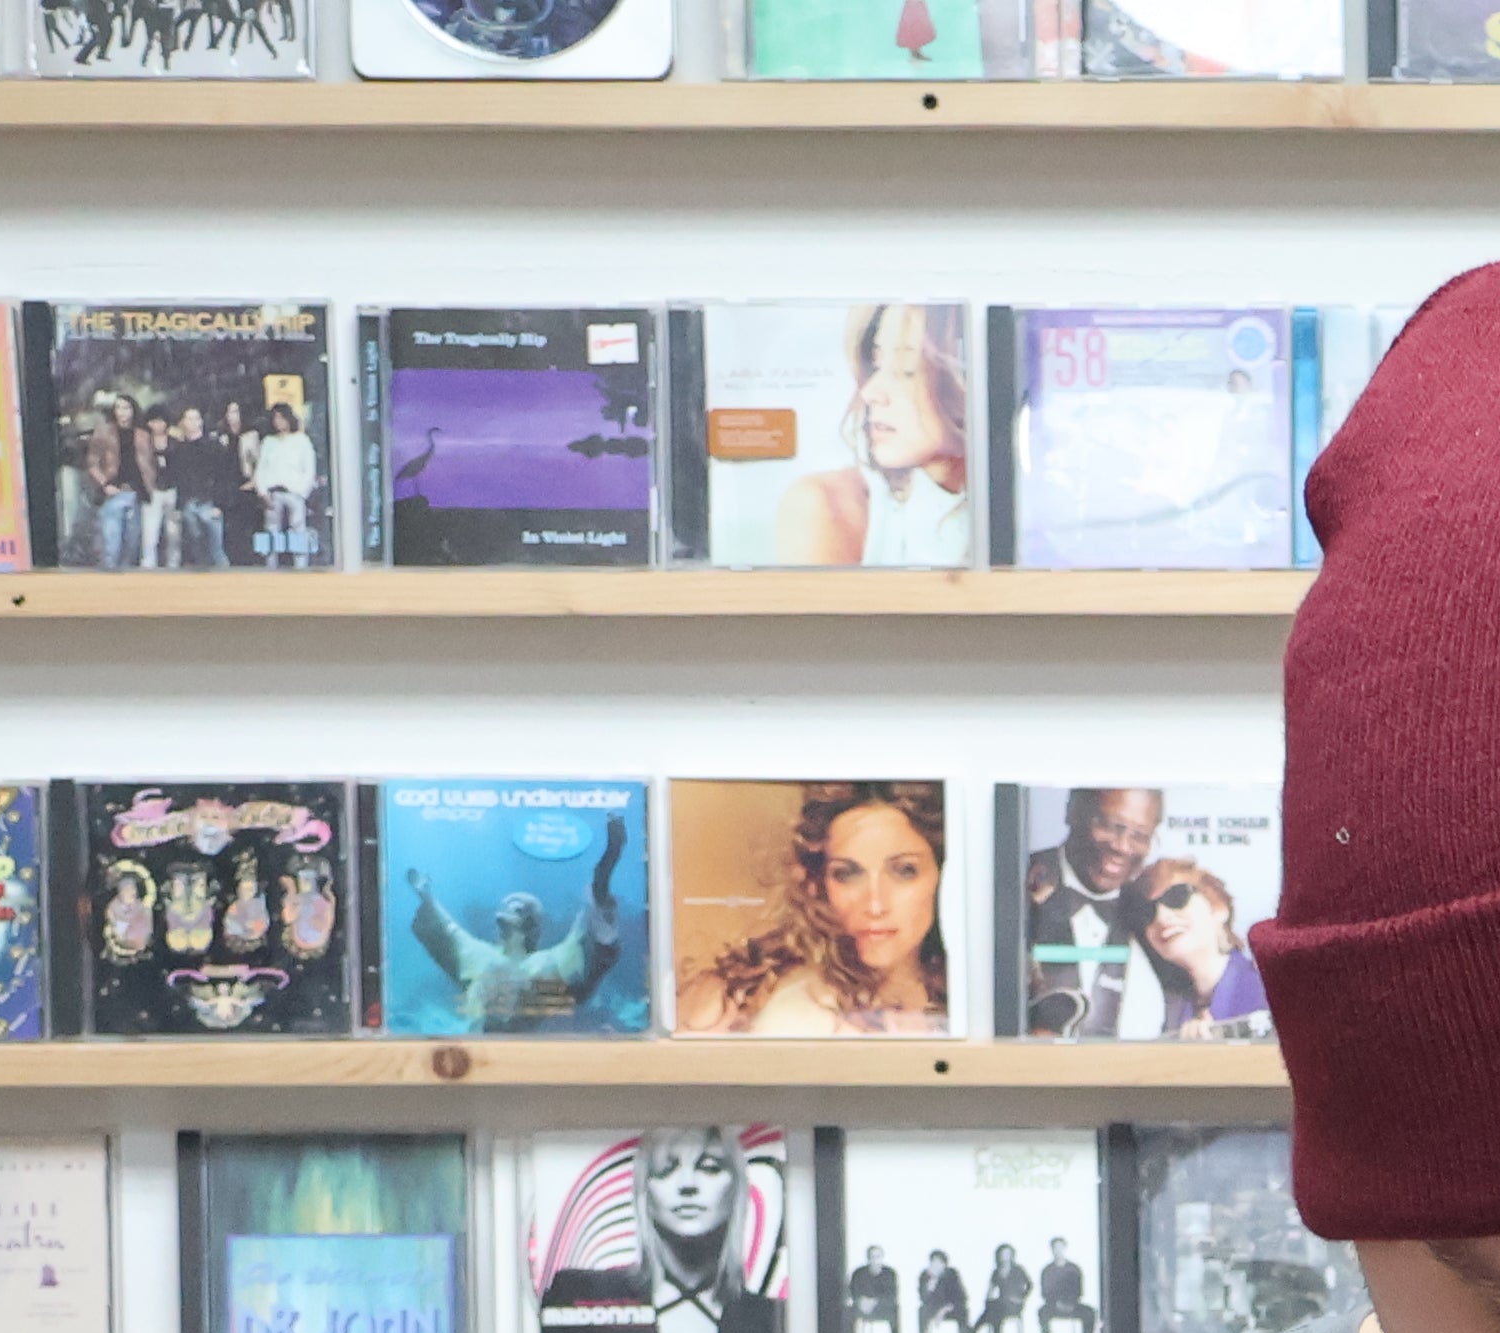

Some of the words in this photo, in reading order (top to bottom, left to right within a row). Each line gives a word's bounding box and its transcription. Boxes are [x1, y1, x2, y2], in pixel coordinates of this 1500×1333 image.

[77, 312, 117, 331] THE
[501, 787, 631, 808] underwater
[541, 1306, 656, 1326] madonna
